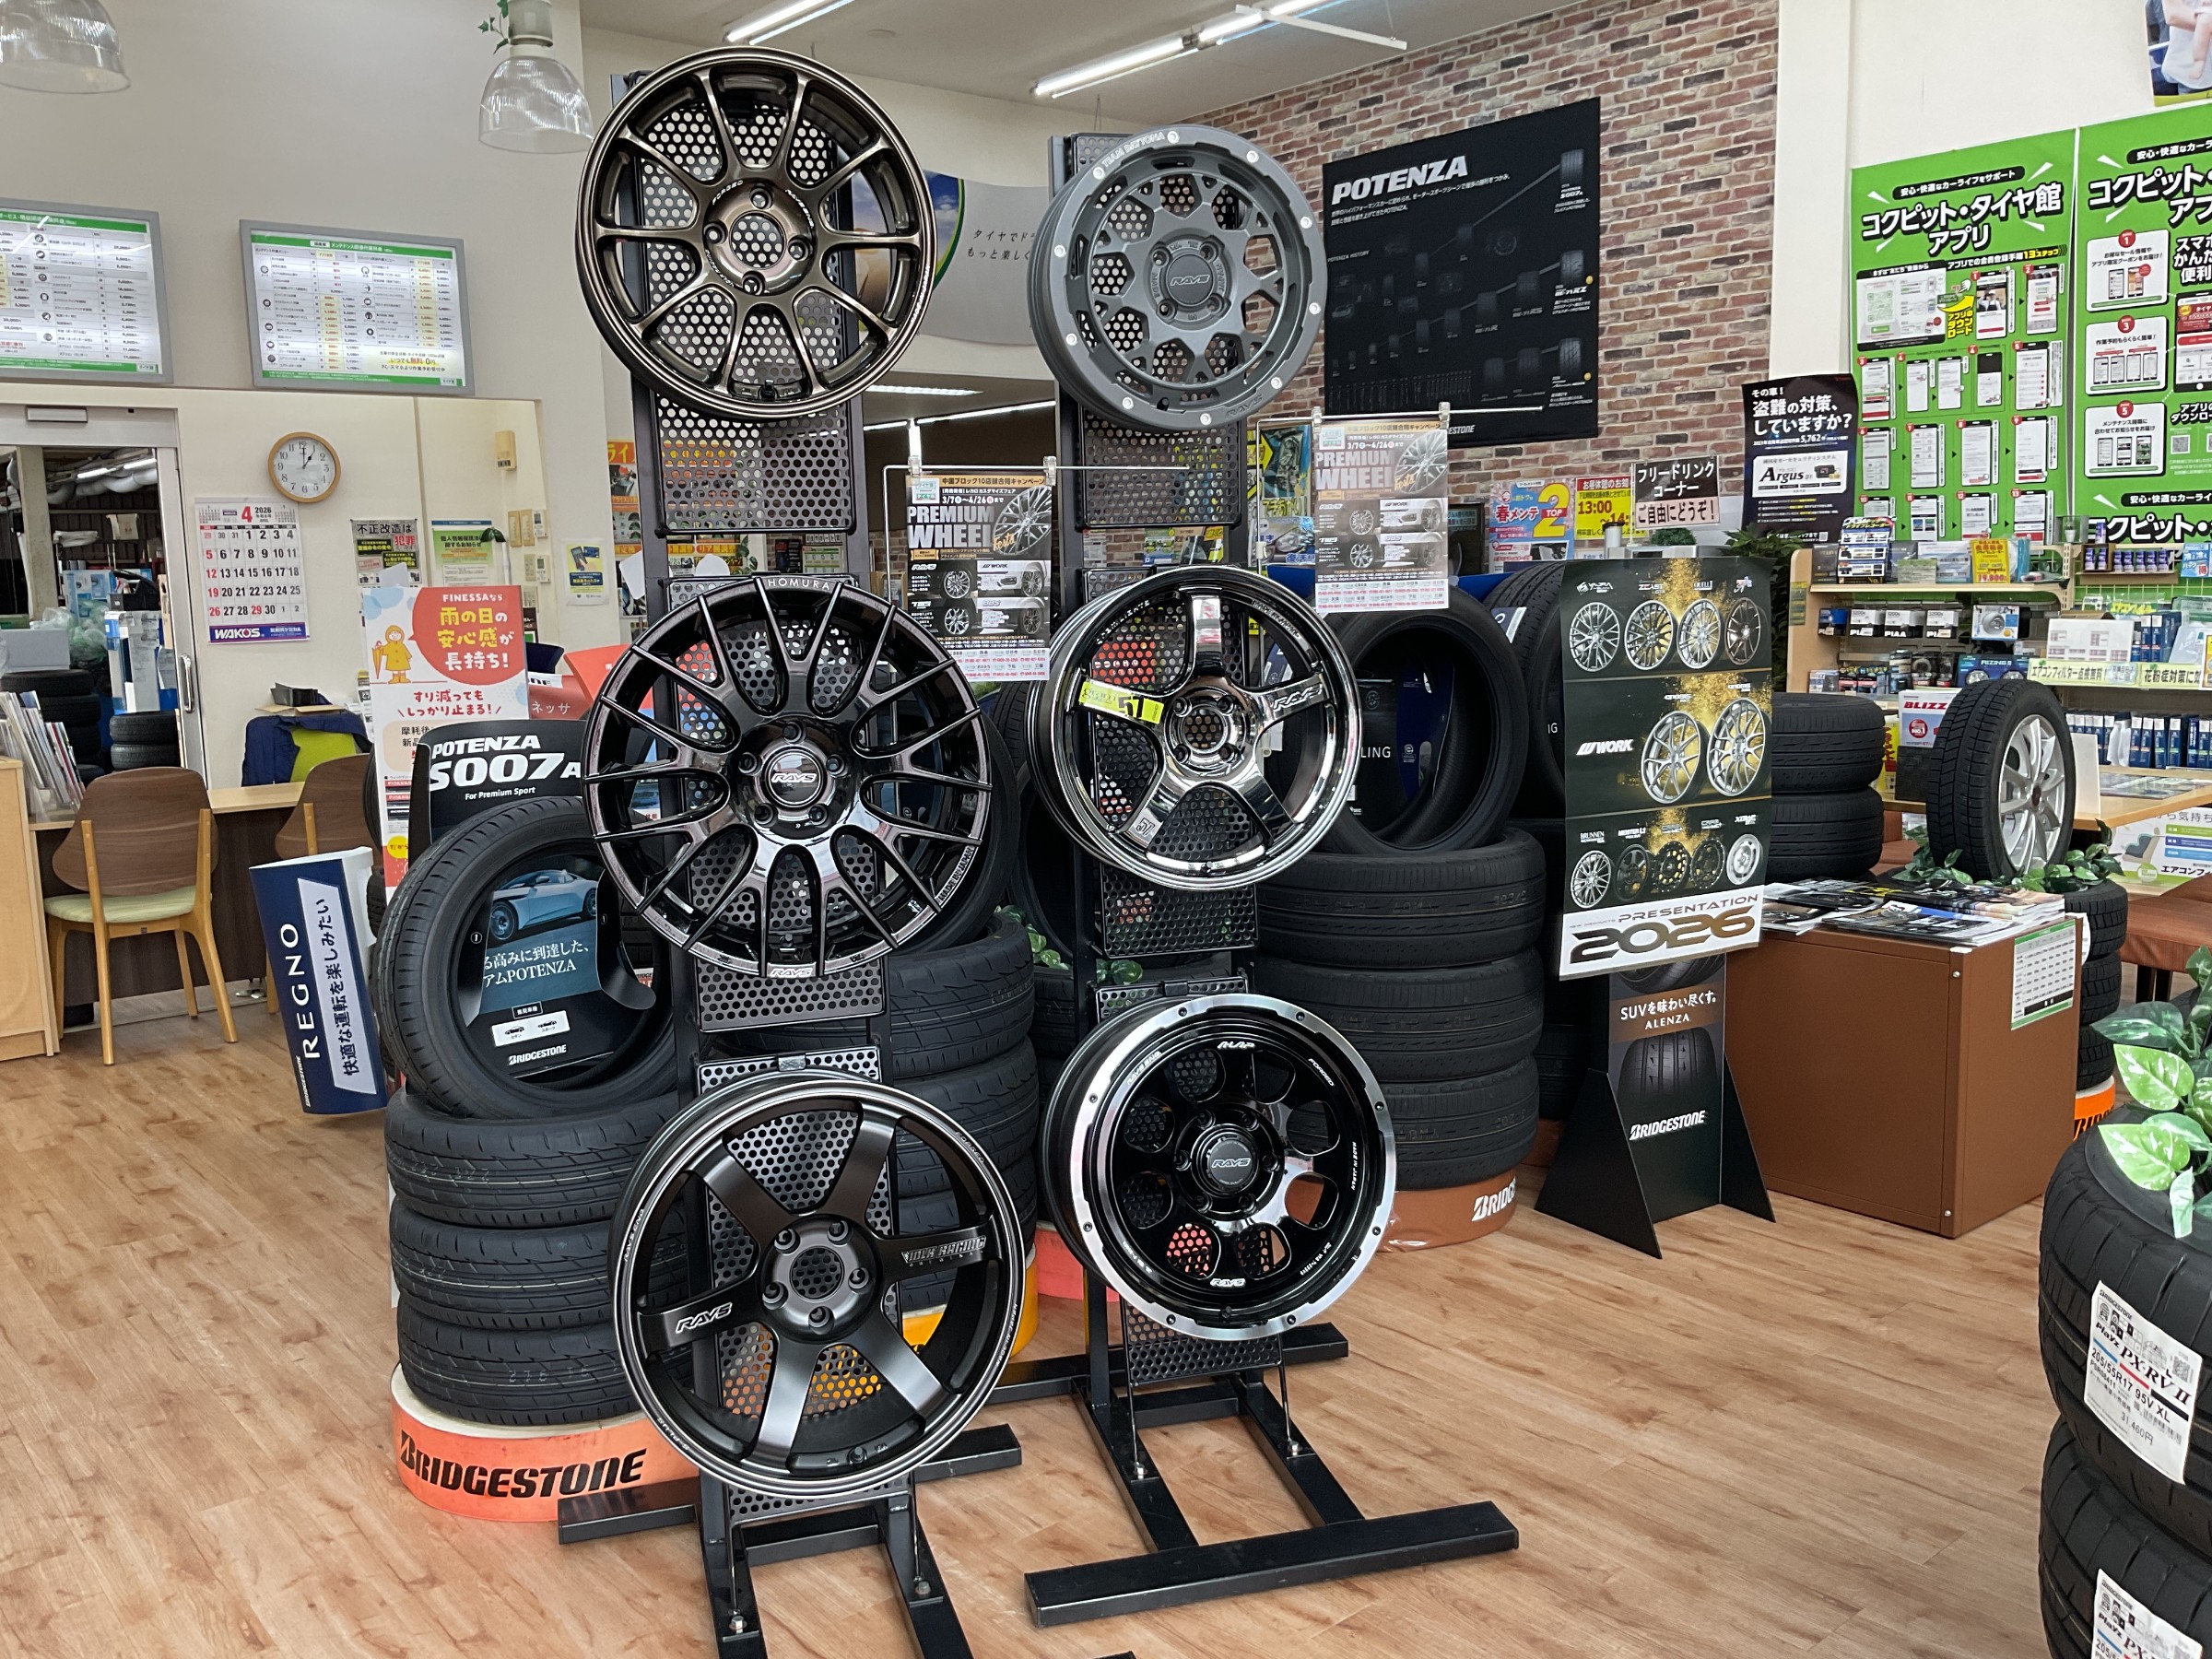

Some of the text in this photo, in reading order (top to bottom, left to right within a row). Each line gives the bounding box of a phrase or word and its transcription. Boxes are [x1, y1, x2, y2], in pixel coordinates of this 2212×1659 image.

[1331, 156, 1468, 205] POTENZA
[1900, 170, 2016, 197] 安心・快適なカーライフをサポート
[1861, 182, 2063, 238] コクピット・タイヤ館
[1928, 224, 1990, 255] アプリ
[968, 246, 1030, 261] もっと楽しく
[1171, 274, 1211, 286] RAYS
[1752, 394, 1838, 418] 盗難の対策、
[1754, 414, 1853, 437] していますか?
[1315, 450, 1394, 467] PREMIUM
[1315, 466, 1391, 490] WHEEL
[1638, 461, 1715, 483] フリードリンク
[1759, 466, 1805, 484] Argus
[1653, 480, 1700, 498] コーナー
[241, 506, 253, 523] 4
[907, 505, 995, 524] PREMIUM
[1496, 505, 1539, 524] 春メンテ
[1533, 482, 1571, 538] 2
[1546, 509, 1563, 518] TOP
[1578, 500, 1613, 515] 13:00
[1638, 499, 1715, 524] ご自由にどうぞ!
[246, 530, 294, 540] 1 2 3 4
[357, 524, 413, 535] 不正改造は
[908, 524, 993, 549] WHEEL
[394, 535, 415, 547] 犯罪
[206, 548, 297, 559] 5 6 7 8 9 10 11
[206, 567, 300, 579] 12 13 14 15 16 17 18
[207, 585, 300, 598] 19 20 21 22 23 24 25
[768, 578, 830, 591] HOMURA
[442, 594, 503, 603] FINESSAなら
[209, 605, 276, 617] 26 27 28 29 30
[440, 606, 508, 626] 雨の日の
[437, 628, 515, 649] 安心感が
[444, 650, 509, 671] 長持ち!
[414, 689, 484, 702] すり減っても
[406, 704, 493, 717] しっかり止まる!
[532, 700, 571, 715] ネッサ
[431, 735, 541, 759] POTENZA
[1360, 746, 1392, 759] LING
[771, 772, 818, 784] RAYS
[465, 786, 536, 801] For Premium Sport
[1618, 893, 1759, 924] PRESENTATION
[1570, 904, 1756, 965] 2026
[770, 966, 814, 978] RAYS
[280, 923, 321, 1059] REGNO
[315, 898, 360, 1077] 快適な運転を楽しみたい
[1620, 989, 1717, 1021] SUVを味わい尽くす。
[1644, 1012, 1690, 1030] ALENZA
[508, 1043, 567, 1065] BRIDGESTONE
[1629, 1110, 1707, 1141] BRIDGESTONE
[1211, 1157, 1252, 1169] RAYS
[1210, 1277, 1246, 1288] RAYS
[2099, 1288, 2133, 1321] BRIDGESTONE
[675, 1301, 732, 1334] RAYS
[2095, 1320, 2120, 1349] Playz
[2091, 1347, 2171, 1424] 205/55R17 95V XL
[400, 1430, 647, 1499] BRIDGESTONE
[2098, 1612, 2123, 1639] Playz
